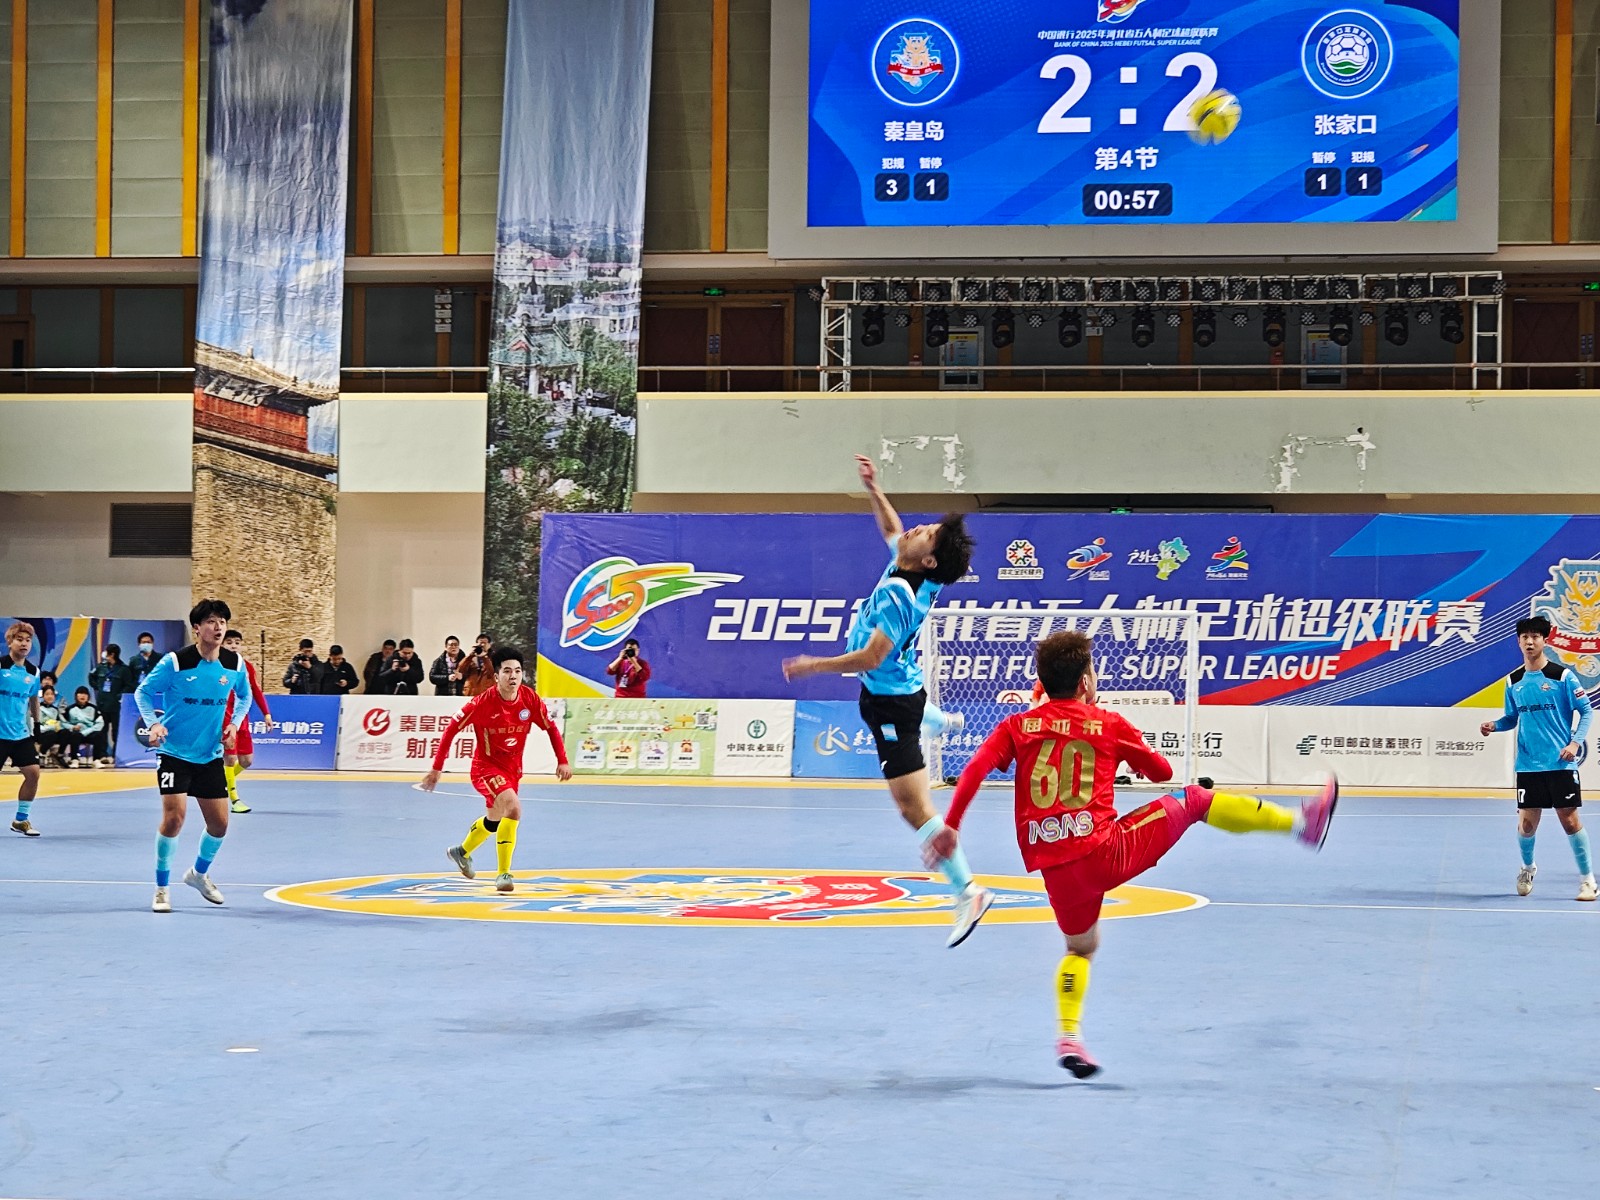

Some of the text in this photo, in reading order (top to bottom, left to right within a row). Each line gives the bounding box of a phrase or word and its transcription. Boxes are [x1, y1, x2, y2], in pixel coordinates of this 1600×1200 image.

[884, 120, 944, 142] 秦皇岛
[1314, 114, 1377, 136] 张家口
[1094, 146, 1159, 171] 第4节
[886, 178, 936, 196] 3 1
[1317, 172, 1368, 190] 1 1
[1094, 190, 1160, 210] 00:57
[706, 593, 1485, 651] 2025北省五人制足球超级联赛
[916, 655, 1000, 680] EBEI
[1005, 655, 1114, 680] FUL
[1223, 655, 1340, 681] LEAGUE
[1142, 731, 1223, 749] 皇岛行
[1320, 737, 1485, 751] 中国邮政储蓄银行 河北省分行
[161, 772, 175, 788] 21
[1029, 738, 1096, 810] 60
